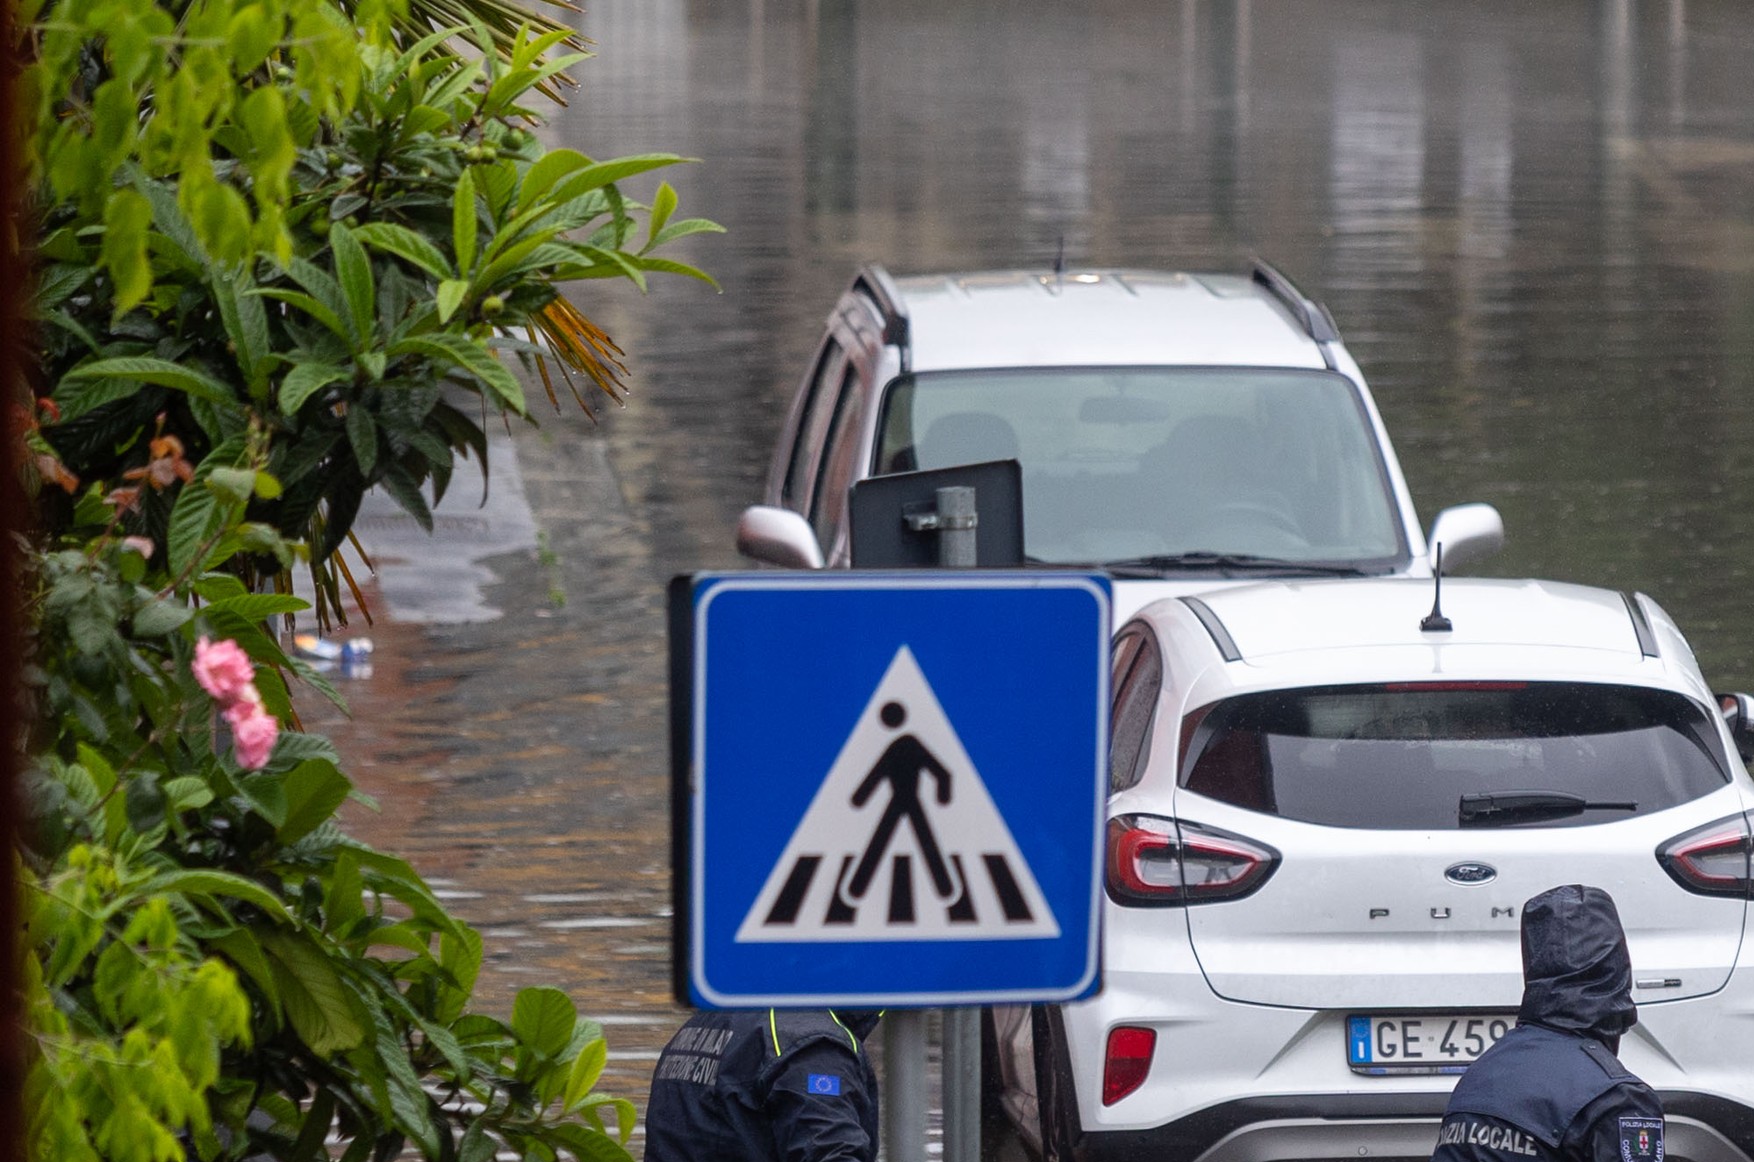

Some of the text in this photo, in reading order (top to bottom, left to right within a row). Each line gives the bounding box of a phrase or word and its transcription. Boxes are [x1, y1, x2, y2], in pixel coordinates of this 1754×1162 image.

[1369, 907, 1515, 920] PUM
[1377, 1020, 1423, 1059] GE
[1468, 1122, 1537, 1156] LOCALE
